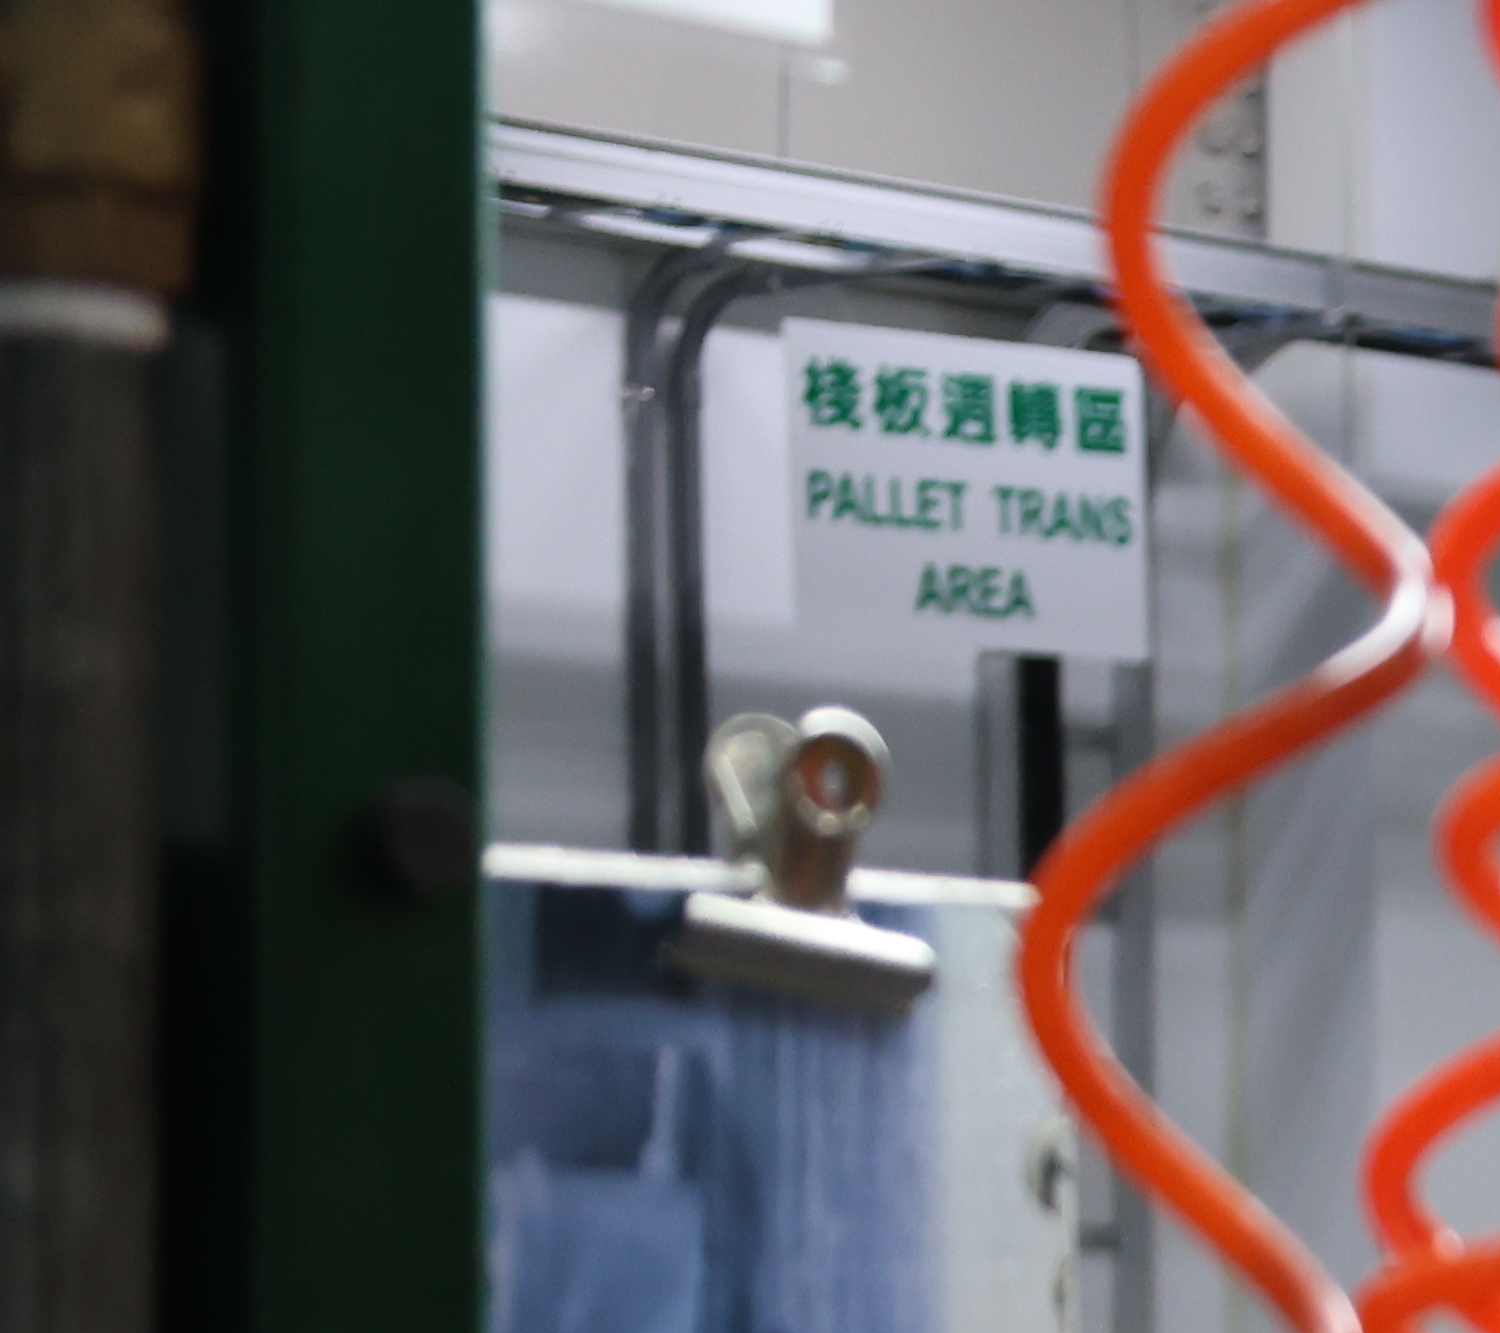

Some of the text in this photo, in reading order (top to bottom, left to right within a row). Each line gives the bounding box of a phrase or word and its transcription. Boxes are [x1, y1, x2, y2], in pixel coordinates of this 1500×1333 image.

[806, 469, 1132, 547] PALLET TRANS
[914, 562, 1037, 619] AREA
